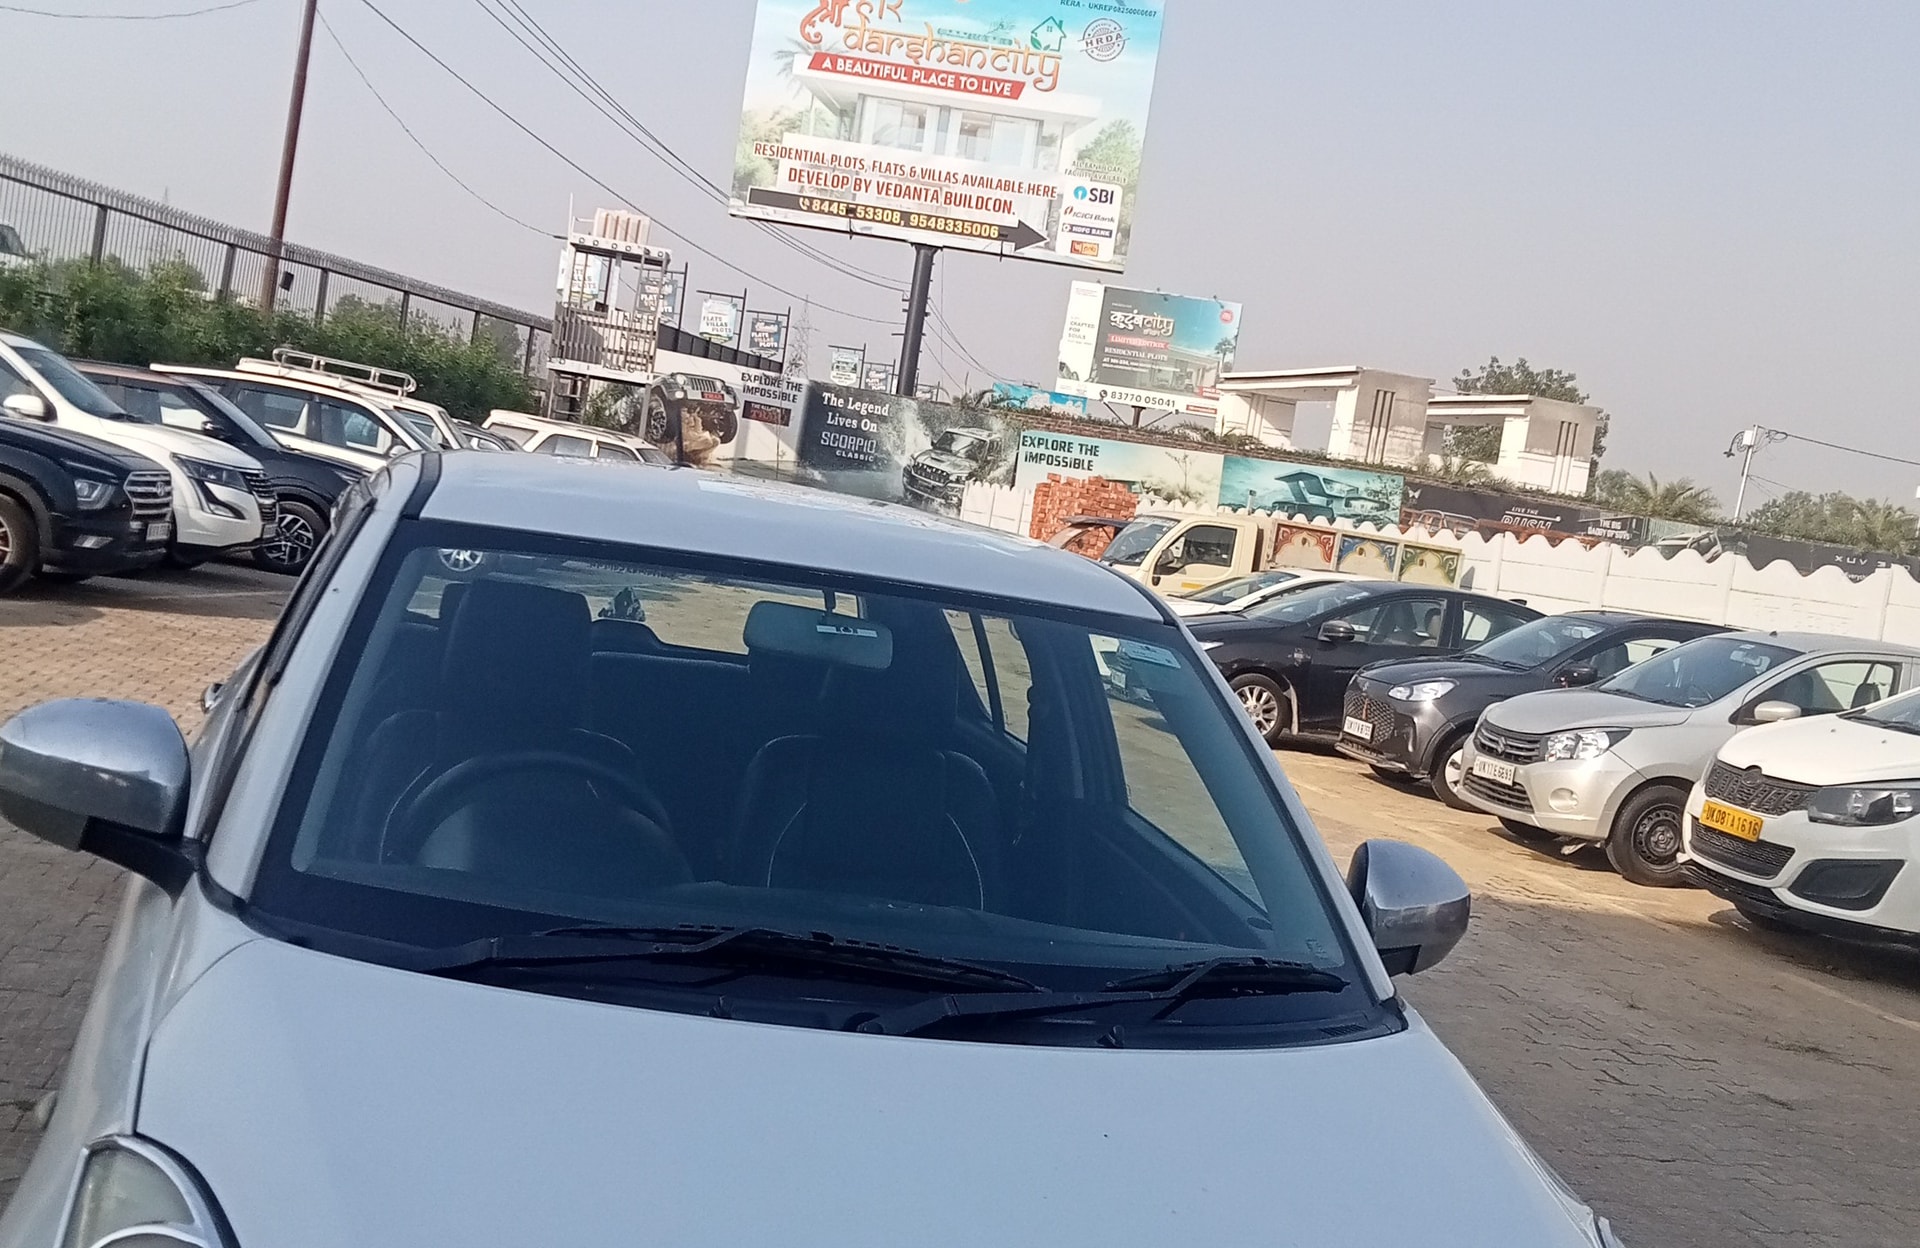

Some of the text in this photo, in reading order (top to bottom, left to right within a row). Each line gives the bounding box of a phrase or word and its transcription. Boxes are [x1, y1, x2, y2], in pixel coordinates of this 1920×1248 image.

[1085, 32, 1123, 48] HRDA
[822, 57, 1013, 96] A BEAUTIFUL PLACE TO LIVE
[754, 142, 1058, 198] RESIDENTIAL PLOTS, FLATS & VILLAS AVAILABLE HERE
[788, 167, 1016, 216] DEVELOP BY VEDANTA BUILDCON.
[1089, 187, 1115, 205] SBI
[909, 213, 999, 239] 9548335006
[1072, 211, 1116, 223] ICICI Bank
[1091, 228, 1111, 237] BANK
[1104, 347, 1168, 361] RESIDENTIAL PLOTS
[741, 372, 804, 393] EXPLORE THE
[822, 391, 890, 417] The Legend
[1110, 391, 1176, 408] 83770 05041
[827, 411, 878, 433] Lives On
[820, 431, 876, 454] SCORPIO
[1021, 435, 1100, 457] EXPLORE THE
[836, 449, 875, 462] CLASSIC
[1600, 519, 1621, 530] THE BIG
[1834, 555, 1868, 566] XUV
[1705, 803, 1759, 837] UK08TA1616
